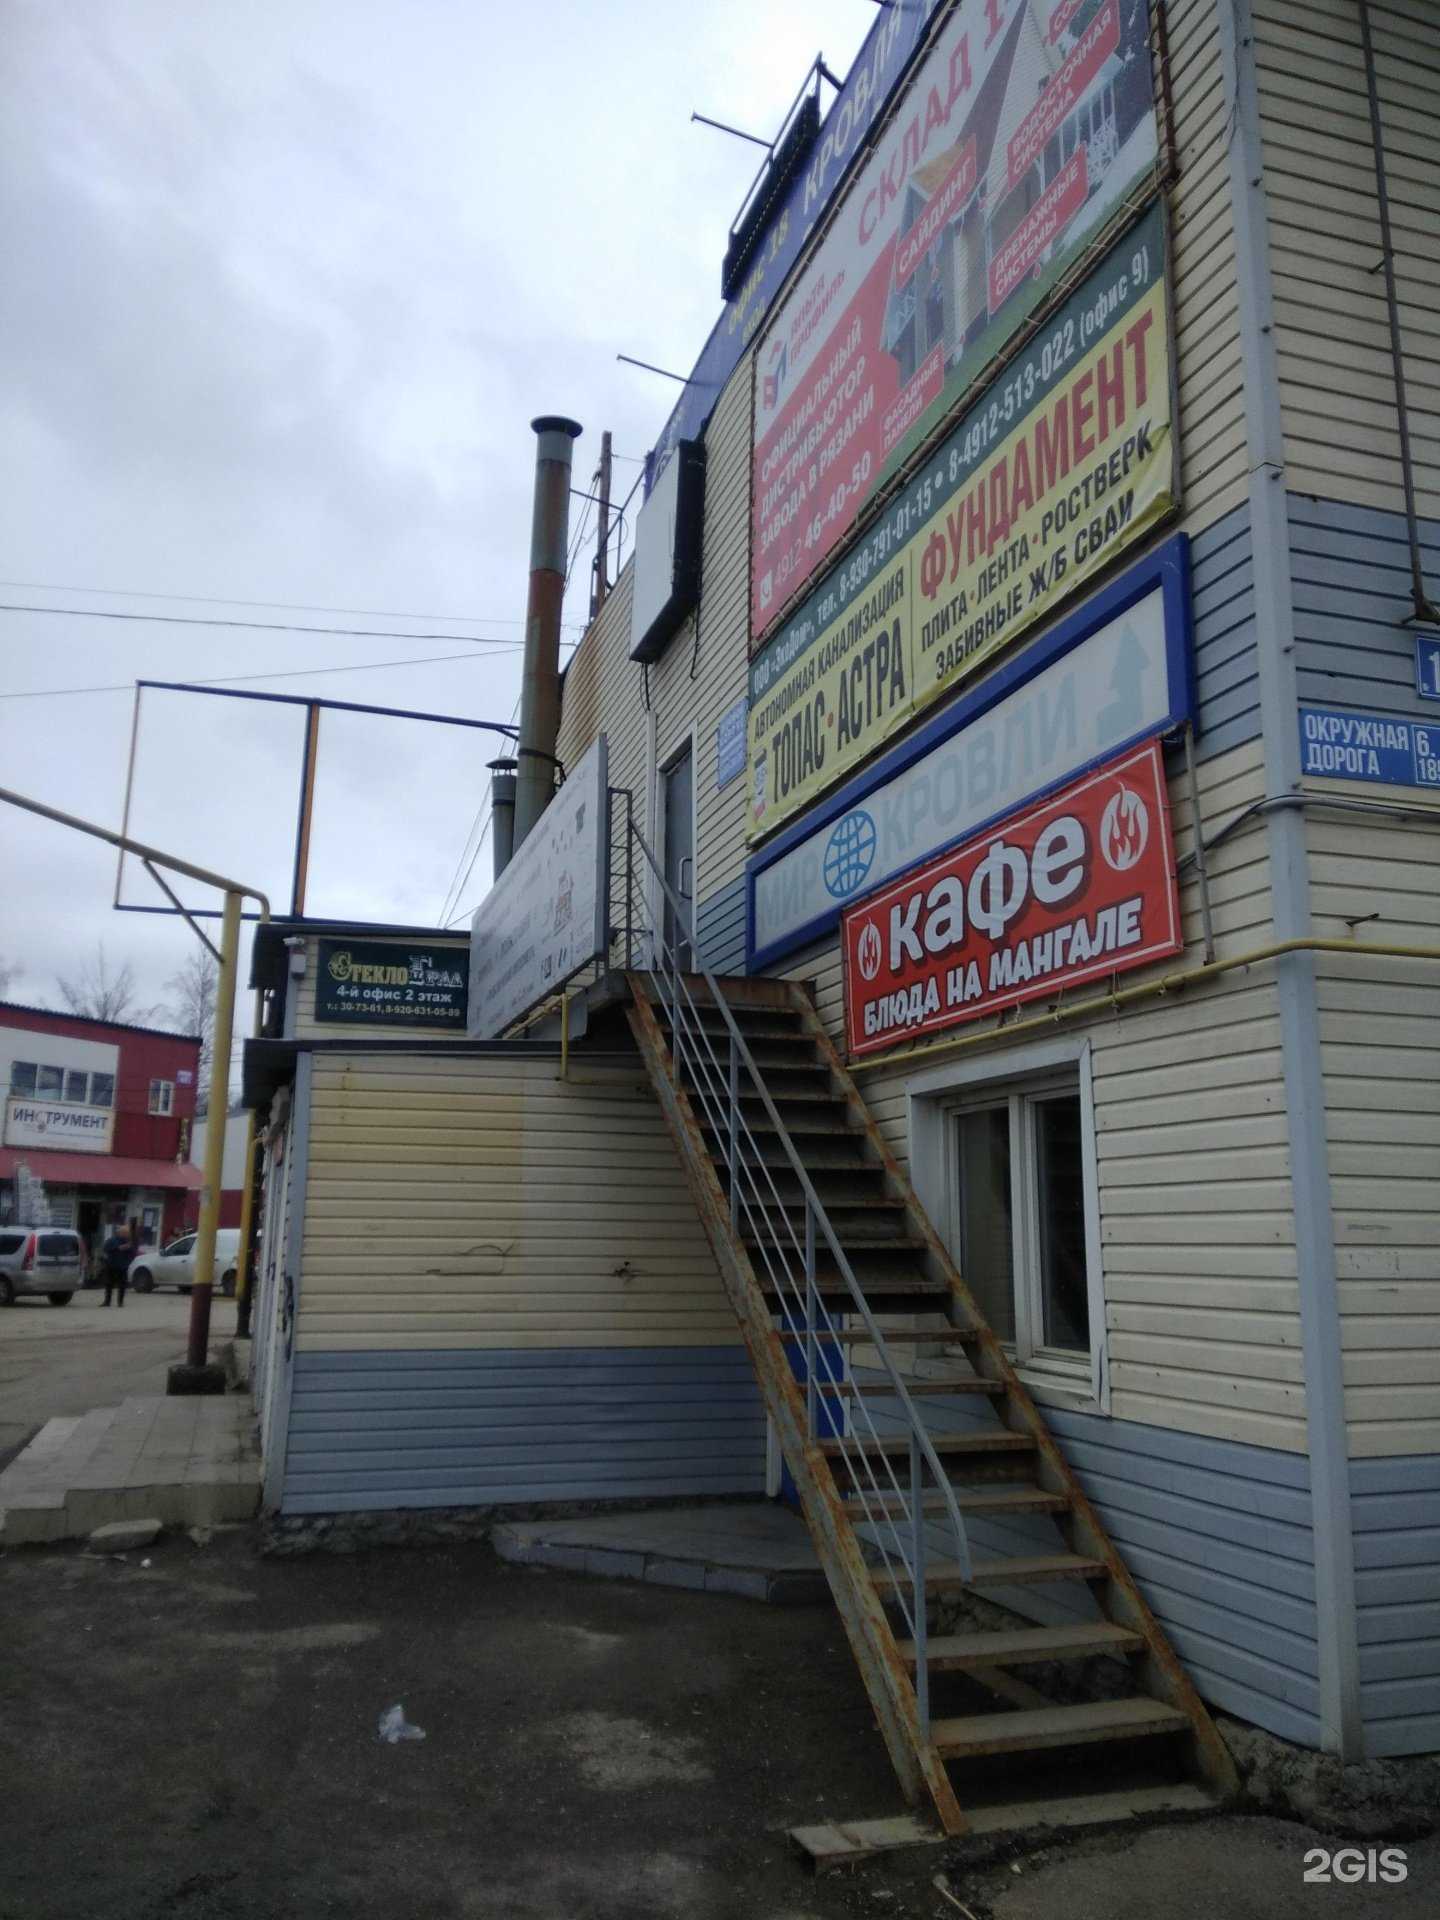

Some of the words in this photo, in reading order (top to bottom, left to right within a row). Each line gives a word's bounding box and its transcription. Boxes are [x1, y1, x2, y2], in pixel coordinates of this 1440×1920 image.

[858, 31, 972, 246] СКЛАД
[1012, 8, 1111, 154] ВОДОСТОЧНАЯ
[1014, 86, 1074, 174] СИСТЕМА
[899, 155, 972, 276] САЙДИНГ
[995, 161, 1079, 280] ДРЕНАЖНЫЕ
[996, 212, 1057, 296] СИСТЕМЫ
[760, 355, 866, 525] ДИСТРИБЬЮТОР
[761, 315, 863, 482] ОФИЦИАЛЬНЫЙ
[761, 481, 807, 553] ЗАВОДА
[809, 464, 817, 492] В
[819, 384, 875, 477] РЯЗАНИ
[817, 592, 837, 625] тел.
[949, 318, 1075, 482] 8-4912-513-022
[1079, 275, 1128, 347] (офис
[1132, 244, 1150, 286] 9)
[920, 308, 1154, 601] ФУНДАМЕНТ
[805, 451, 871, 549] 46-40-50
[921, 590, 969, 652] ПЛИТА
[976, 533, 1030, 604] ЛЕНТА
[1041, 419, 1154, 548] РОСТВЕРК
[754, 657, 815, 744] АВТОНОМНАЯ
[817, 566, 905, 680] КАНАЛИЗАЦИЯ
[935, 582, 1022, 681] ЗАБИВНЫЕ
[1028, 545, 1067, 603] Ж/Б
[1074, 488, 1135, 565] СВАИ
[772, 689, 825, 804] ТОПАС
[837, 615, 905, 752] АСТРА
[881, 672, 1077, 862] КРОВЛИ
[1304, 714, 1410, 751] ОКРУЖНАЯ
[1306, 743, 1381, 776] ДОРОГА
[336, 985, 359, 999] 4-й
[363, 987, 401, 1001] офис
[405, 989, 414, 1001] 2
[418, 992, 452, 1003] этаж
[864, 976, 941, 1037] БЛЮДА
[947, 961, 983, 1006] НА
[988, 898, 1142, 992] МАНГАЛЕ
